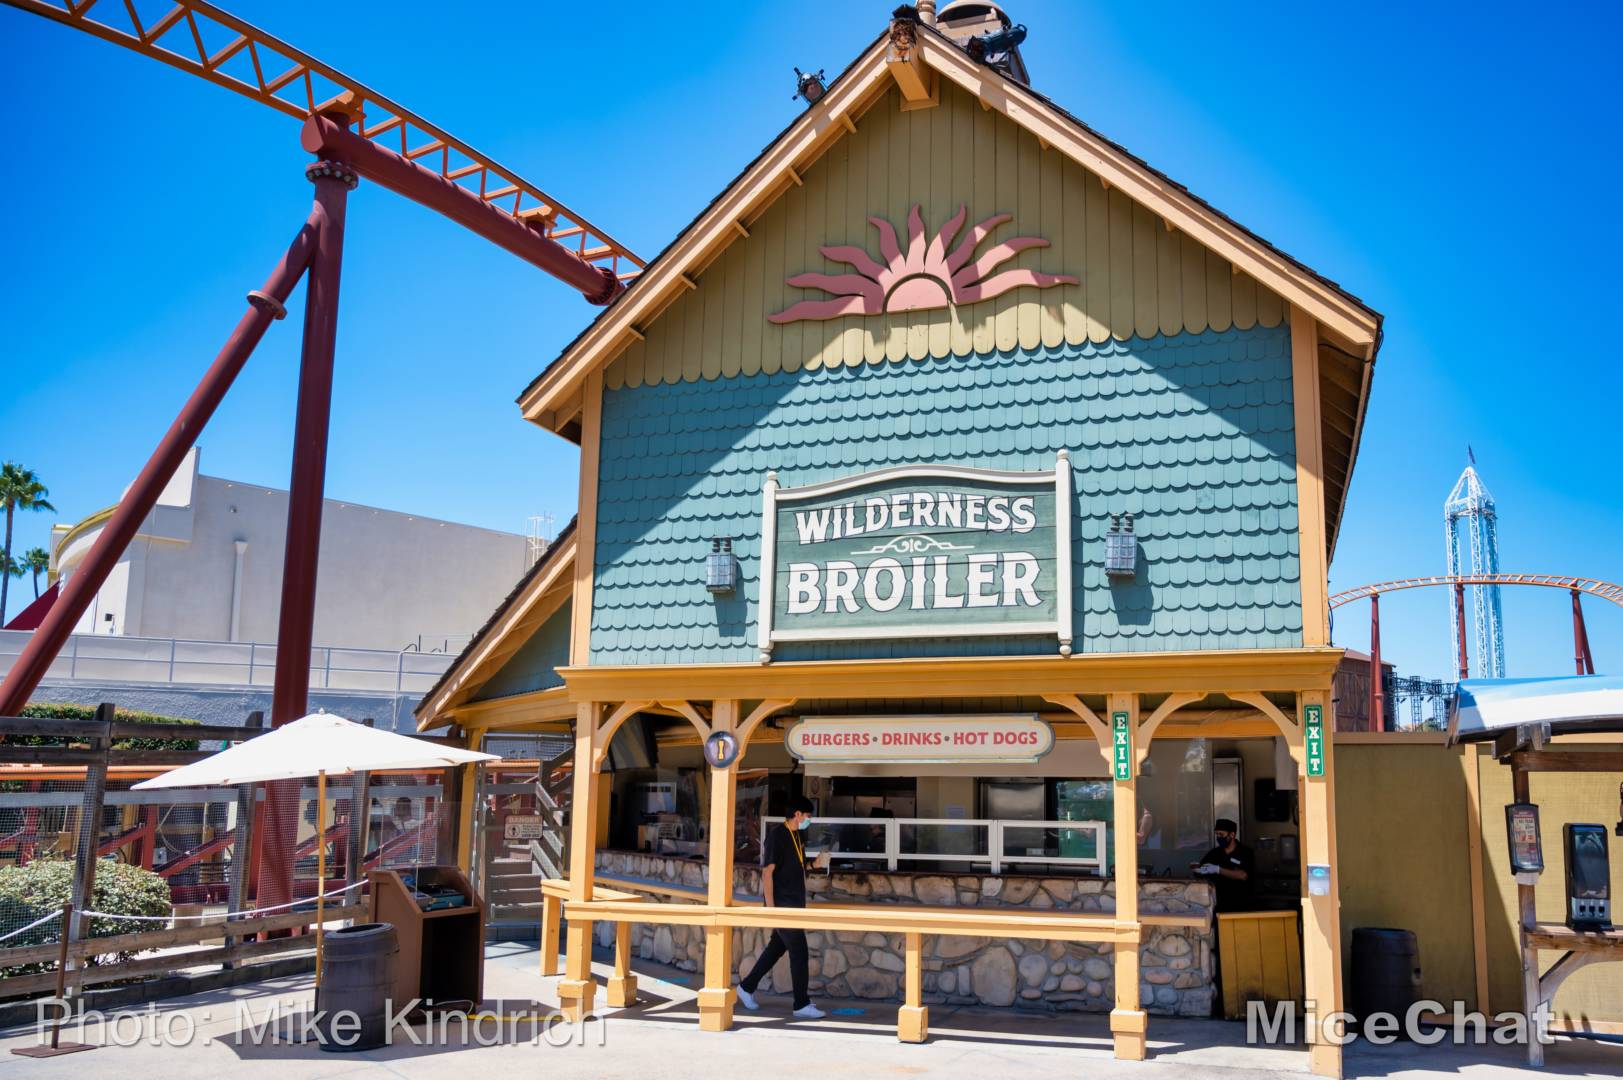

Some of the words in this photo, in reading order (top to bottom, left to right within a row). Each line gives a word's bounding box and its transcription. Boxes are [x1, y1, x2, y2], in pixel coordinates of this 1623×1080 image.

[795, 491, 1036, 545] WILDERNESS
[785, 551, 1045, 615] BROILER
[801, 733, 870, 746] BURGERS
[881, 732, 942, 745] DRINKS
[953, 732, 988, 745] HOT
[993, 731, 1038, 745] DOGS
[1115, 716, 1127, 776] EXIT
[1307, 709, 1321, 772] EXIT
